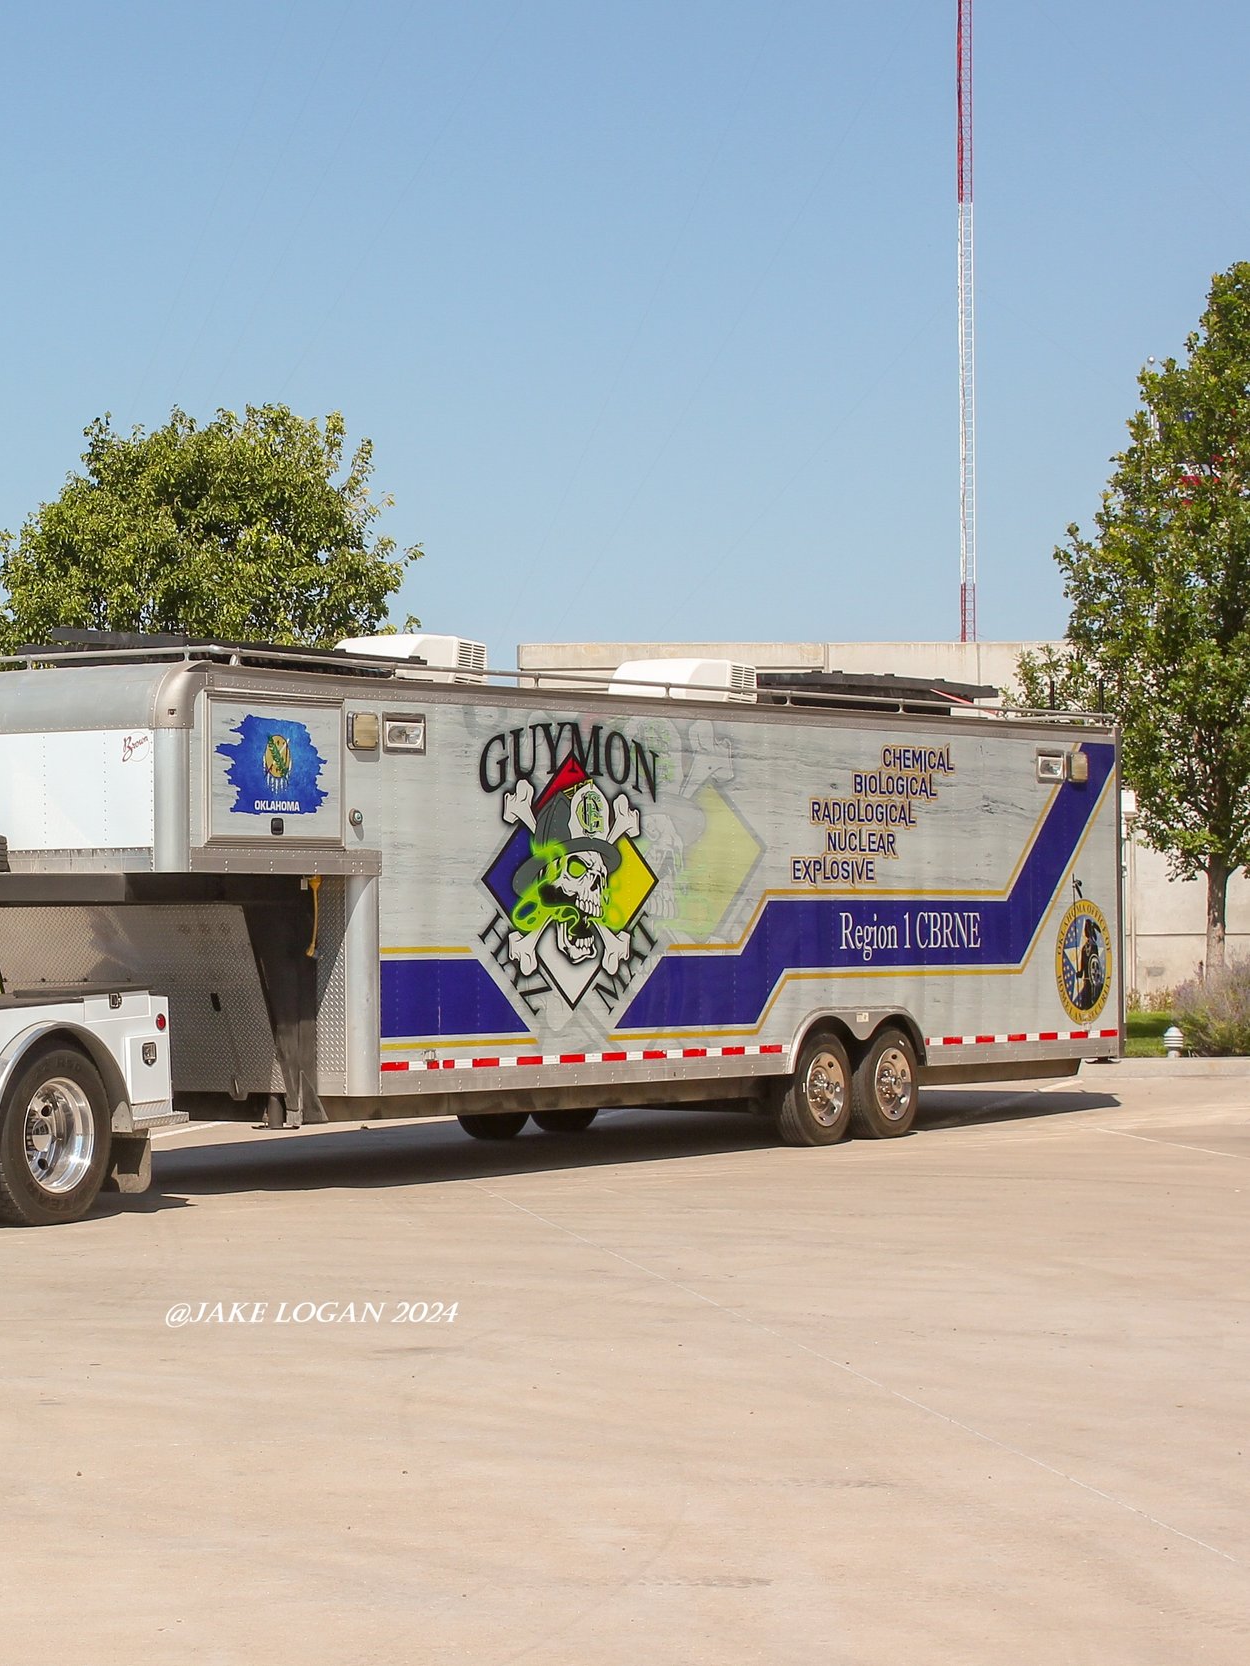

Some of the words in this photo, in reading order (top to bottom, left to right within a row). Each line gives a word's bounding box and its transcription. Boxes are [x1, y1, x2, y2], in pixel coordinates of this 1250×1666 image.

[122, 734, 149, 762] Brown
[479, 721, 660, 803] GUYMON
[882, 746, 954, 774] CHEMICAL
[853, 770, 938, 800] BIOLOGICAL
[254, 799, 301, 812] OKLAHOMA
[811, 798, 916, 827] RADIOLOGICAL
[827, 828, 897, 856] NUCLEAR
[792, 855, 875, 885] EXPLOSIVE
[839, 911, 898, 961] Region
[903, 911, 911, 948] 1
[915, 911, 981, 949] CBRNE
[1057, 904, 1086, 955] OKLAHOMA
[1086, 904, 1107, 933] OFFICE
[1057, 975, 1086, 1021] HOMELAN
